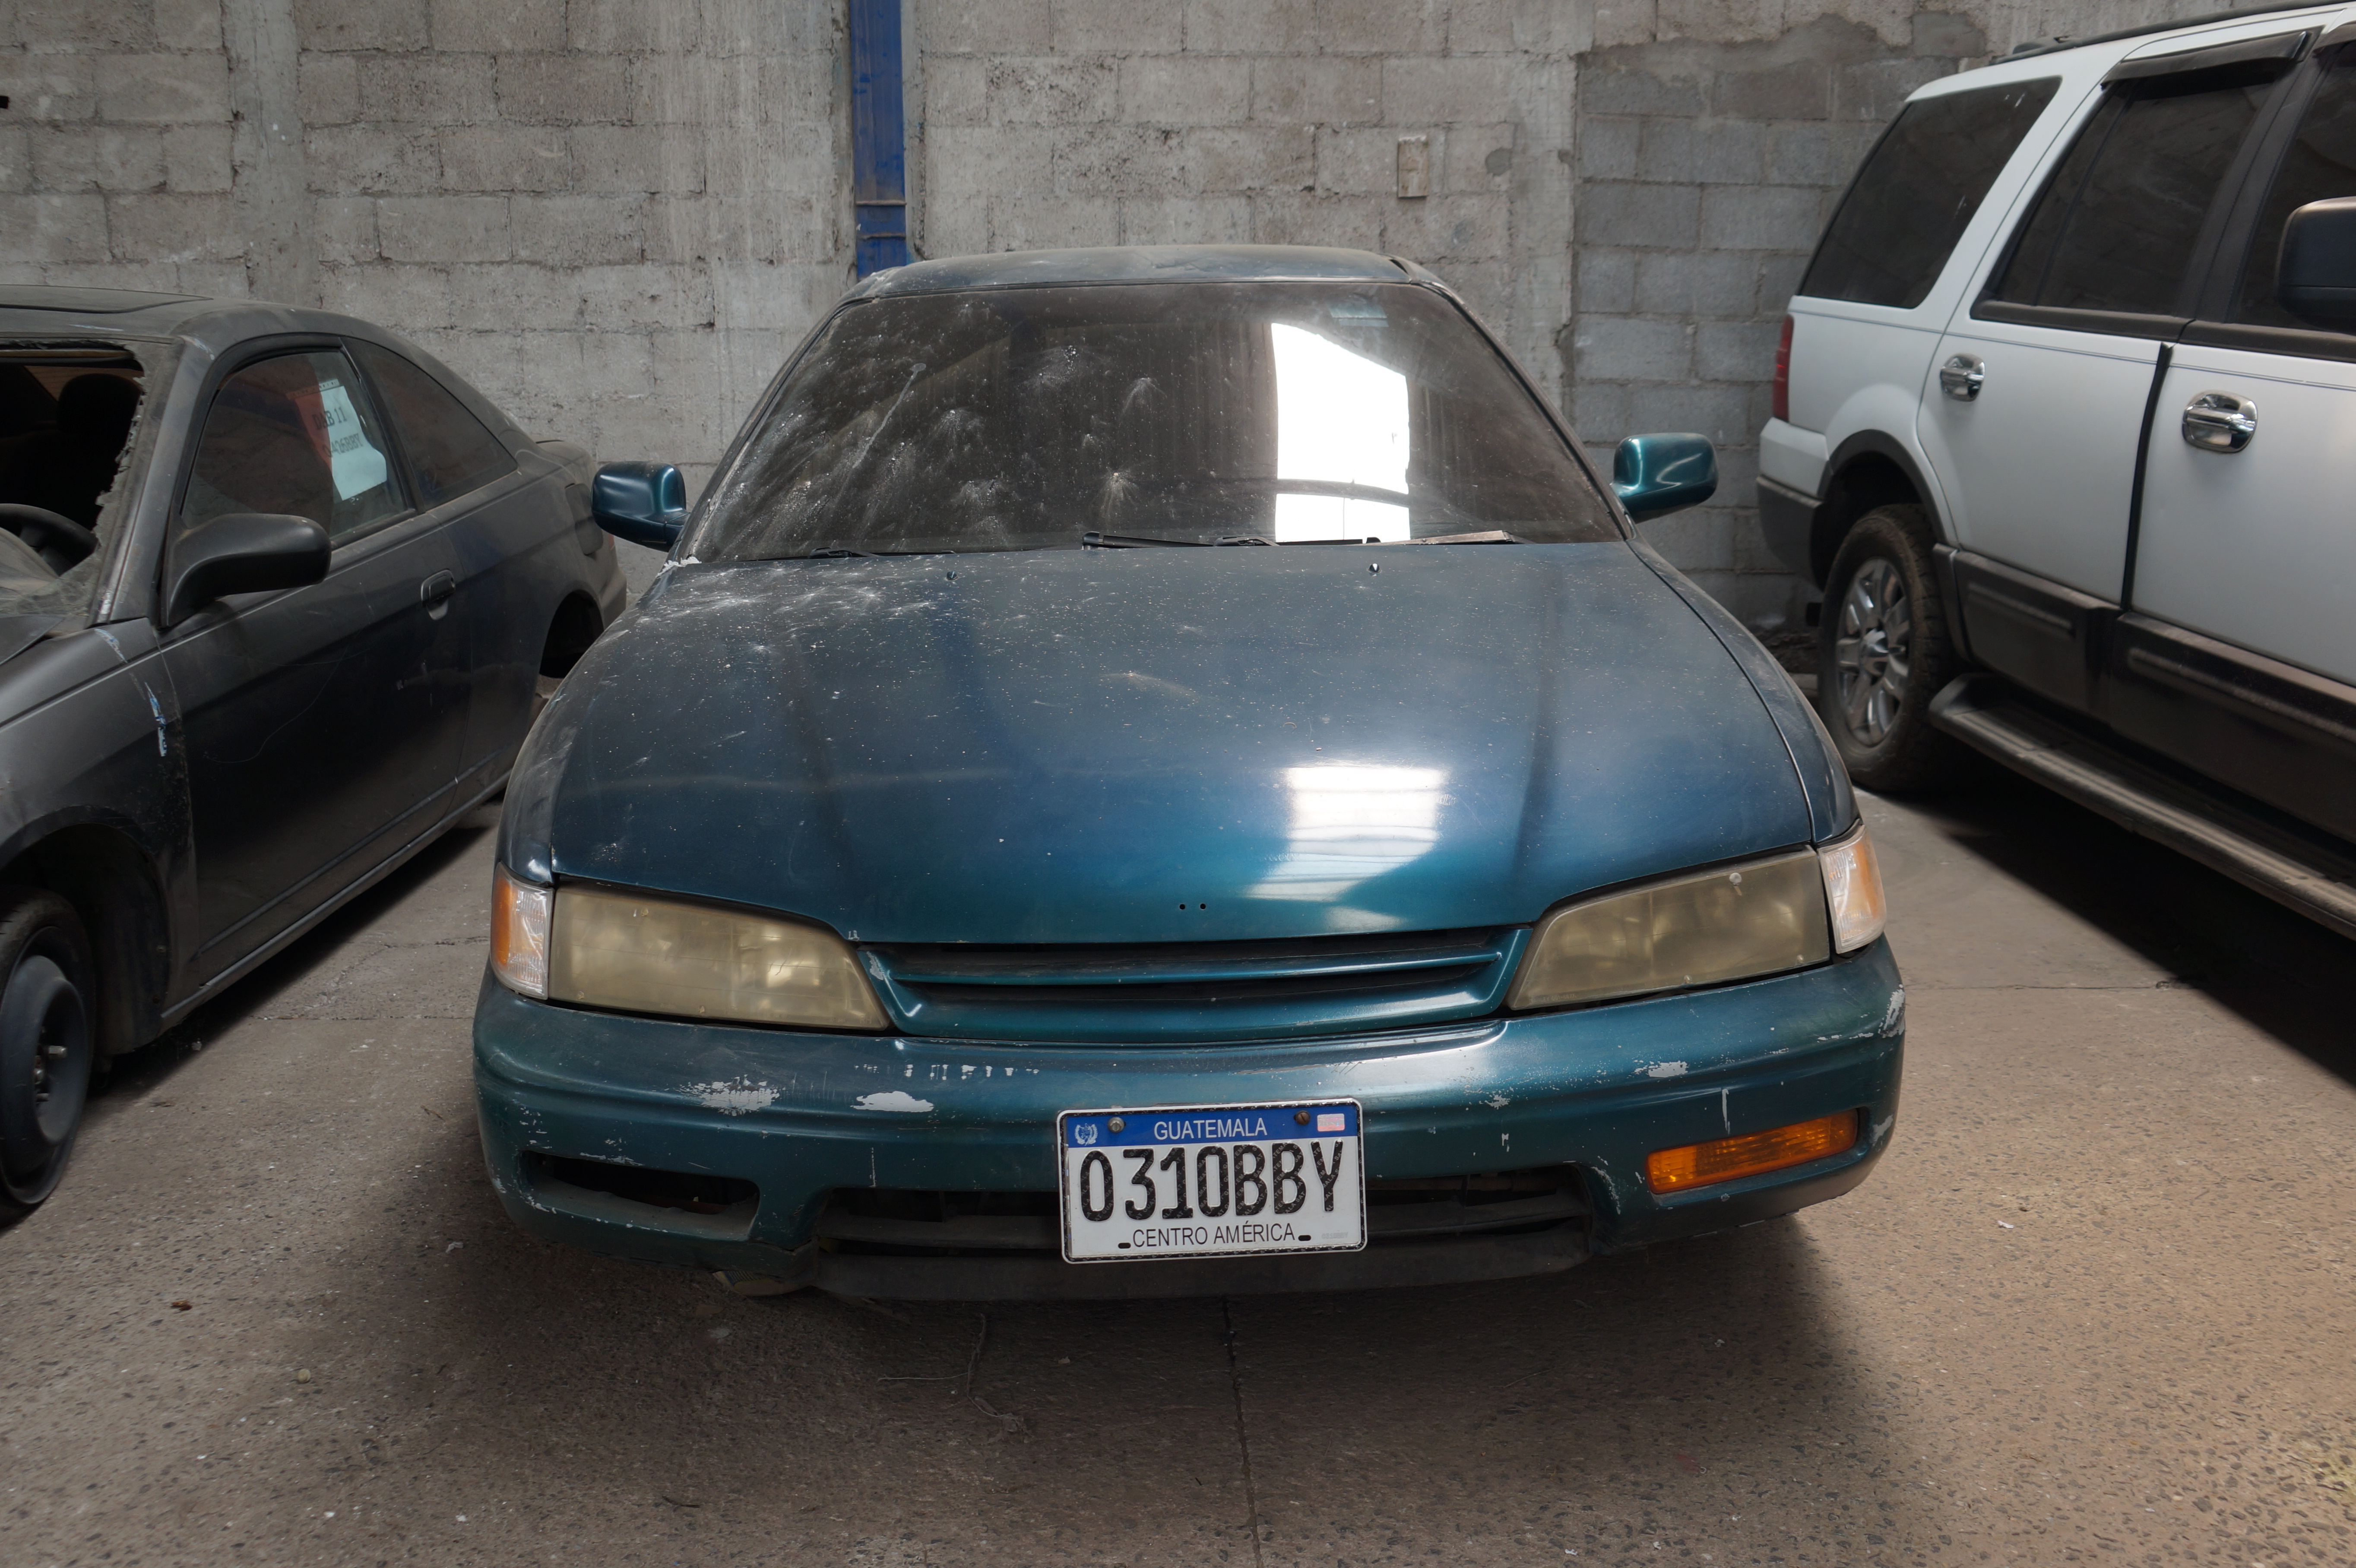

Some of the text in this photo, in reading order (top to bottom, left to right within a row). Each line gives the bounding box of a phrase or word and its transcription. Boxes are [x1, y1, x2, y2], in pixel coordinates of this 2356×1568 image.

[1154, 1117, 1267, 1140] GUATEMALA
[1133, 1220, 1295, 1248] CENTRO AMÉRICA
